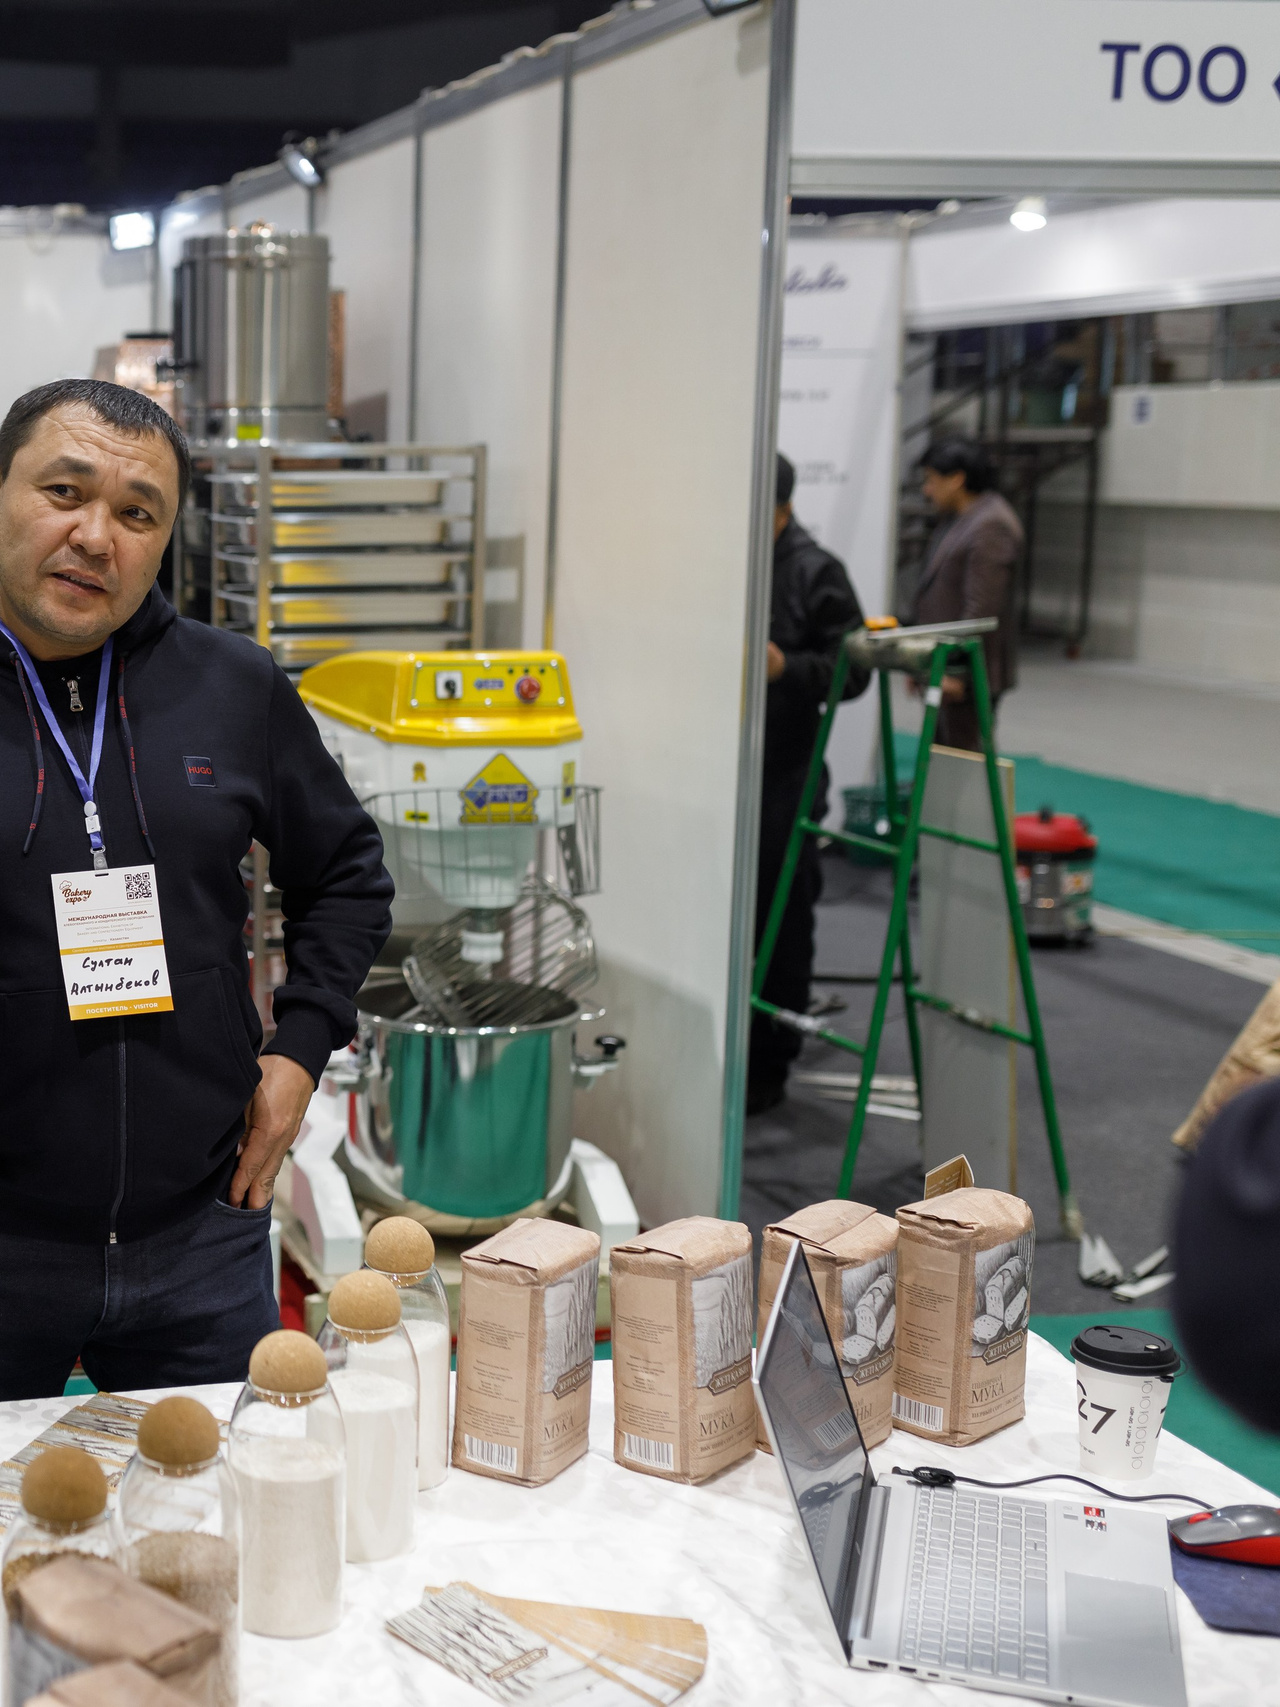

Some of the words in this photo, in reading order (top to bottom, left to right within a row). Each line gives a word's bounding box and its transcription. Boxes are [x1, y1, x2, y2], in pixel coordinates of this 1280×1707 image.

[188, 766, 213, 775] HUGO
[62, 888, 92, 898] Bakery
[67, 913, 118, 922] МЕЖДУНАРОДНАЯ
[82, 956, 133, 972] Султан
[70, 969, 160, 996] Алтынбеков
[86, 1005, 128, 1015] ПОСЕТИТЕЛЬ
[133, 1002, 159, 1010] VISITOR
[971, 1381, 1005, 1404] МУКА
[543, 1415, 575, 1442] МУКА
[699, 1412, 736, 1438] МУКА
